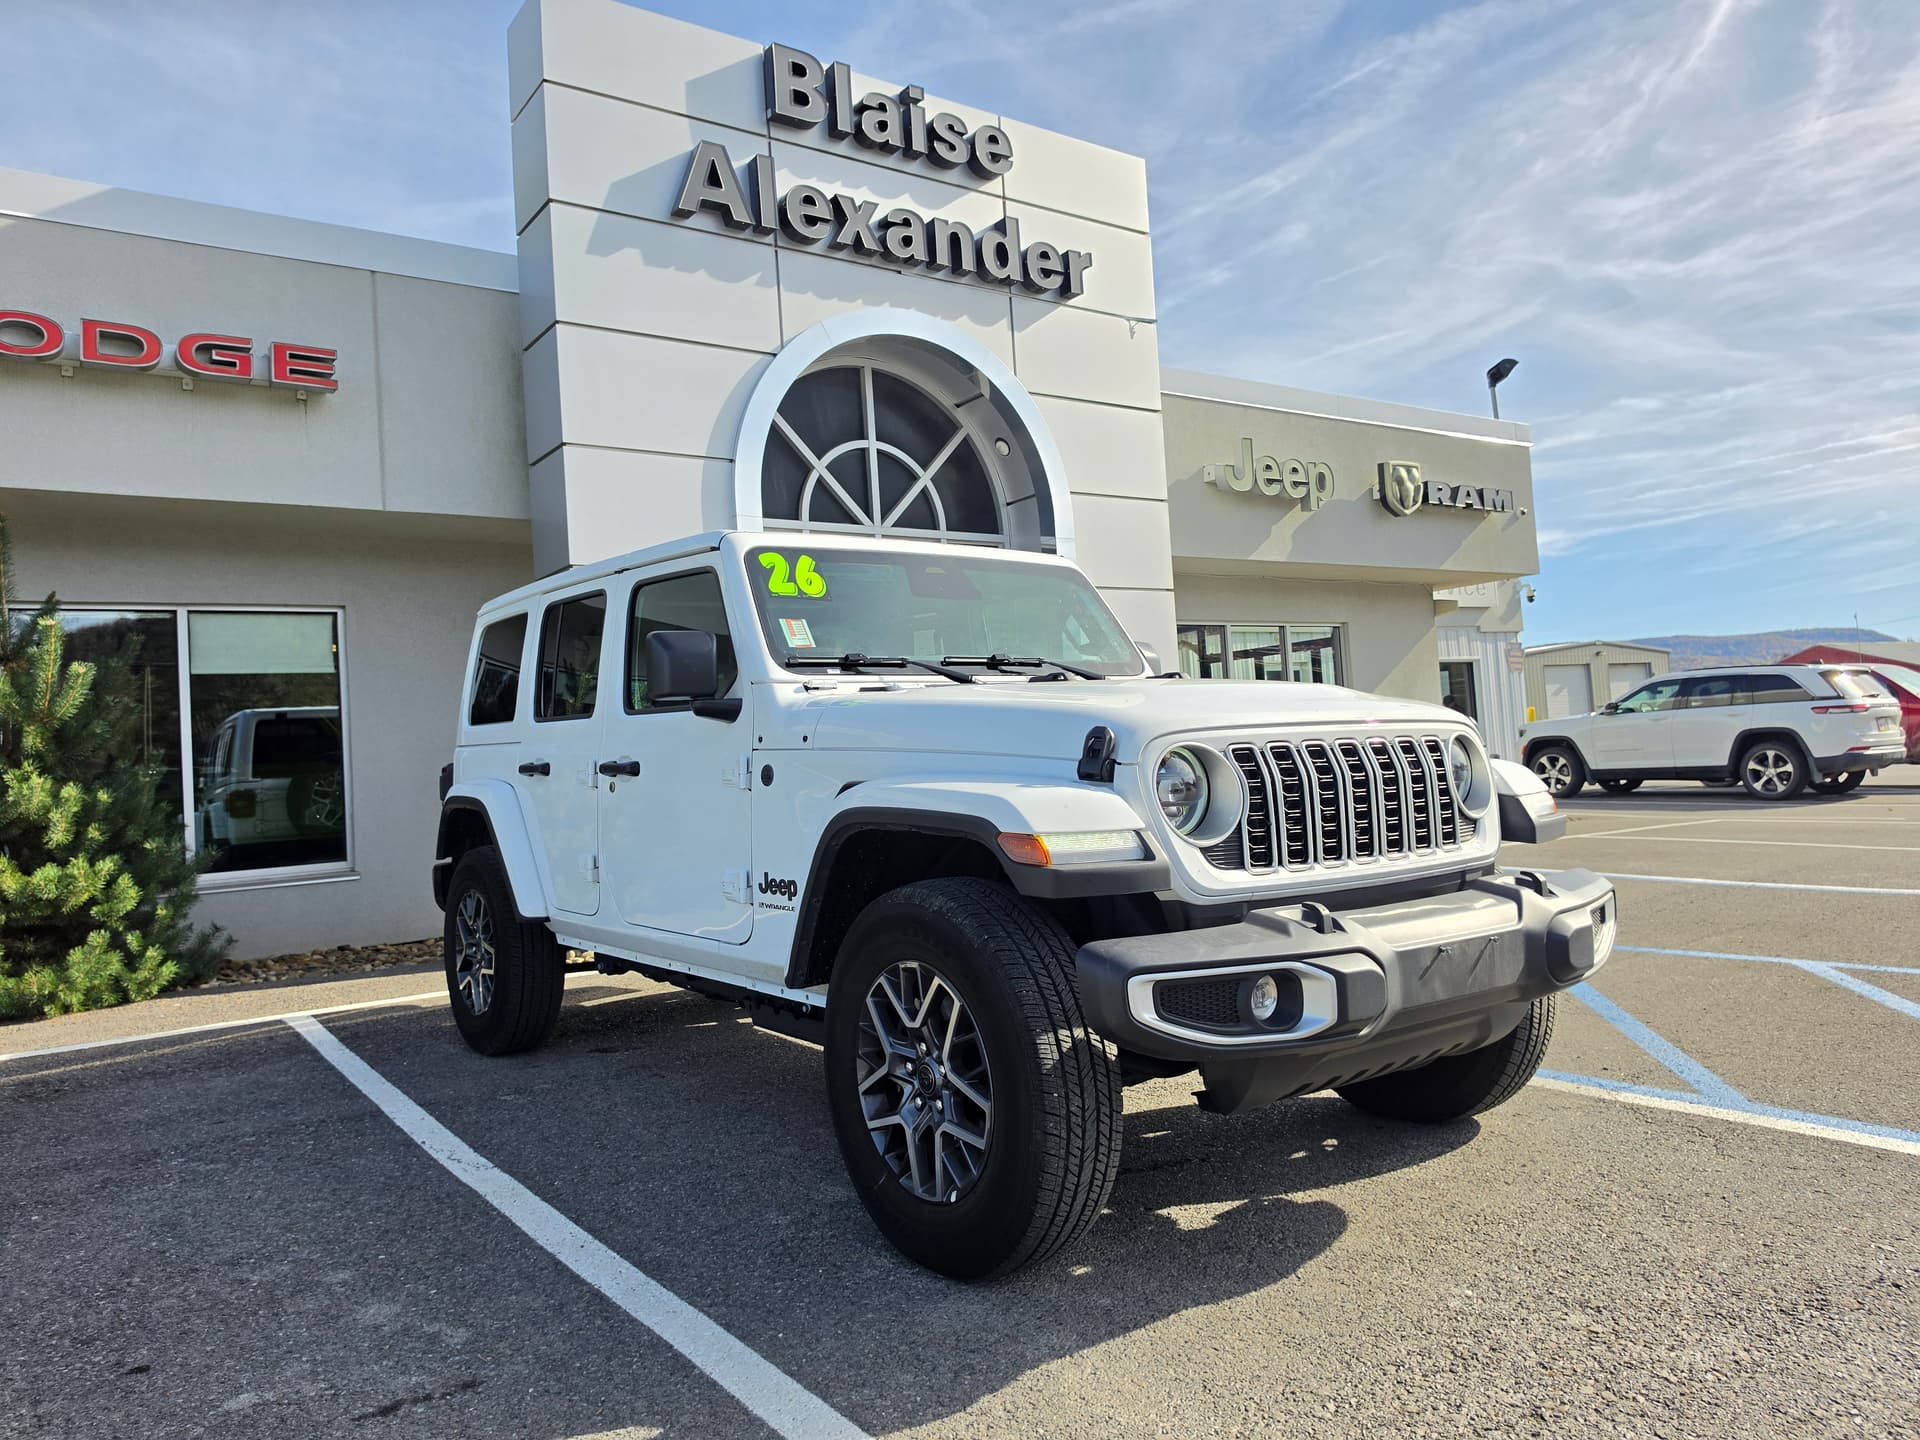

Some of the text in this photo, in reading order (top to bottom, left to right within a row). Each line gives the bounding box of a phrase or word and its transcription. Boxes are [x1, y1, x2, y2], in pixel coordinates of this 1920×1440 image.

[764, 42, 1013, 180] Blaise
[671, 140, 1093, 300] Alexander
[1224, 437, 1335, 511] Jeep
[1424, 479, 1514, 512] RAM
[758, 551, 827, 598] 26
[758, 871, 798, 901] Jeep
